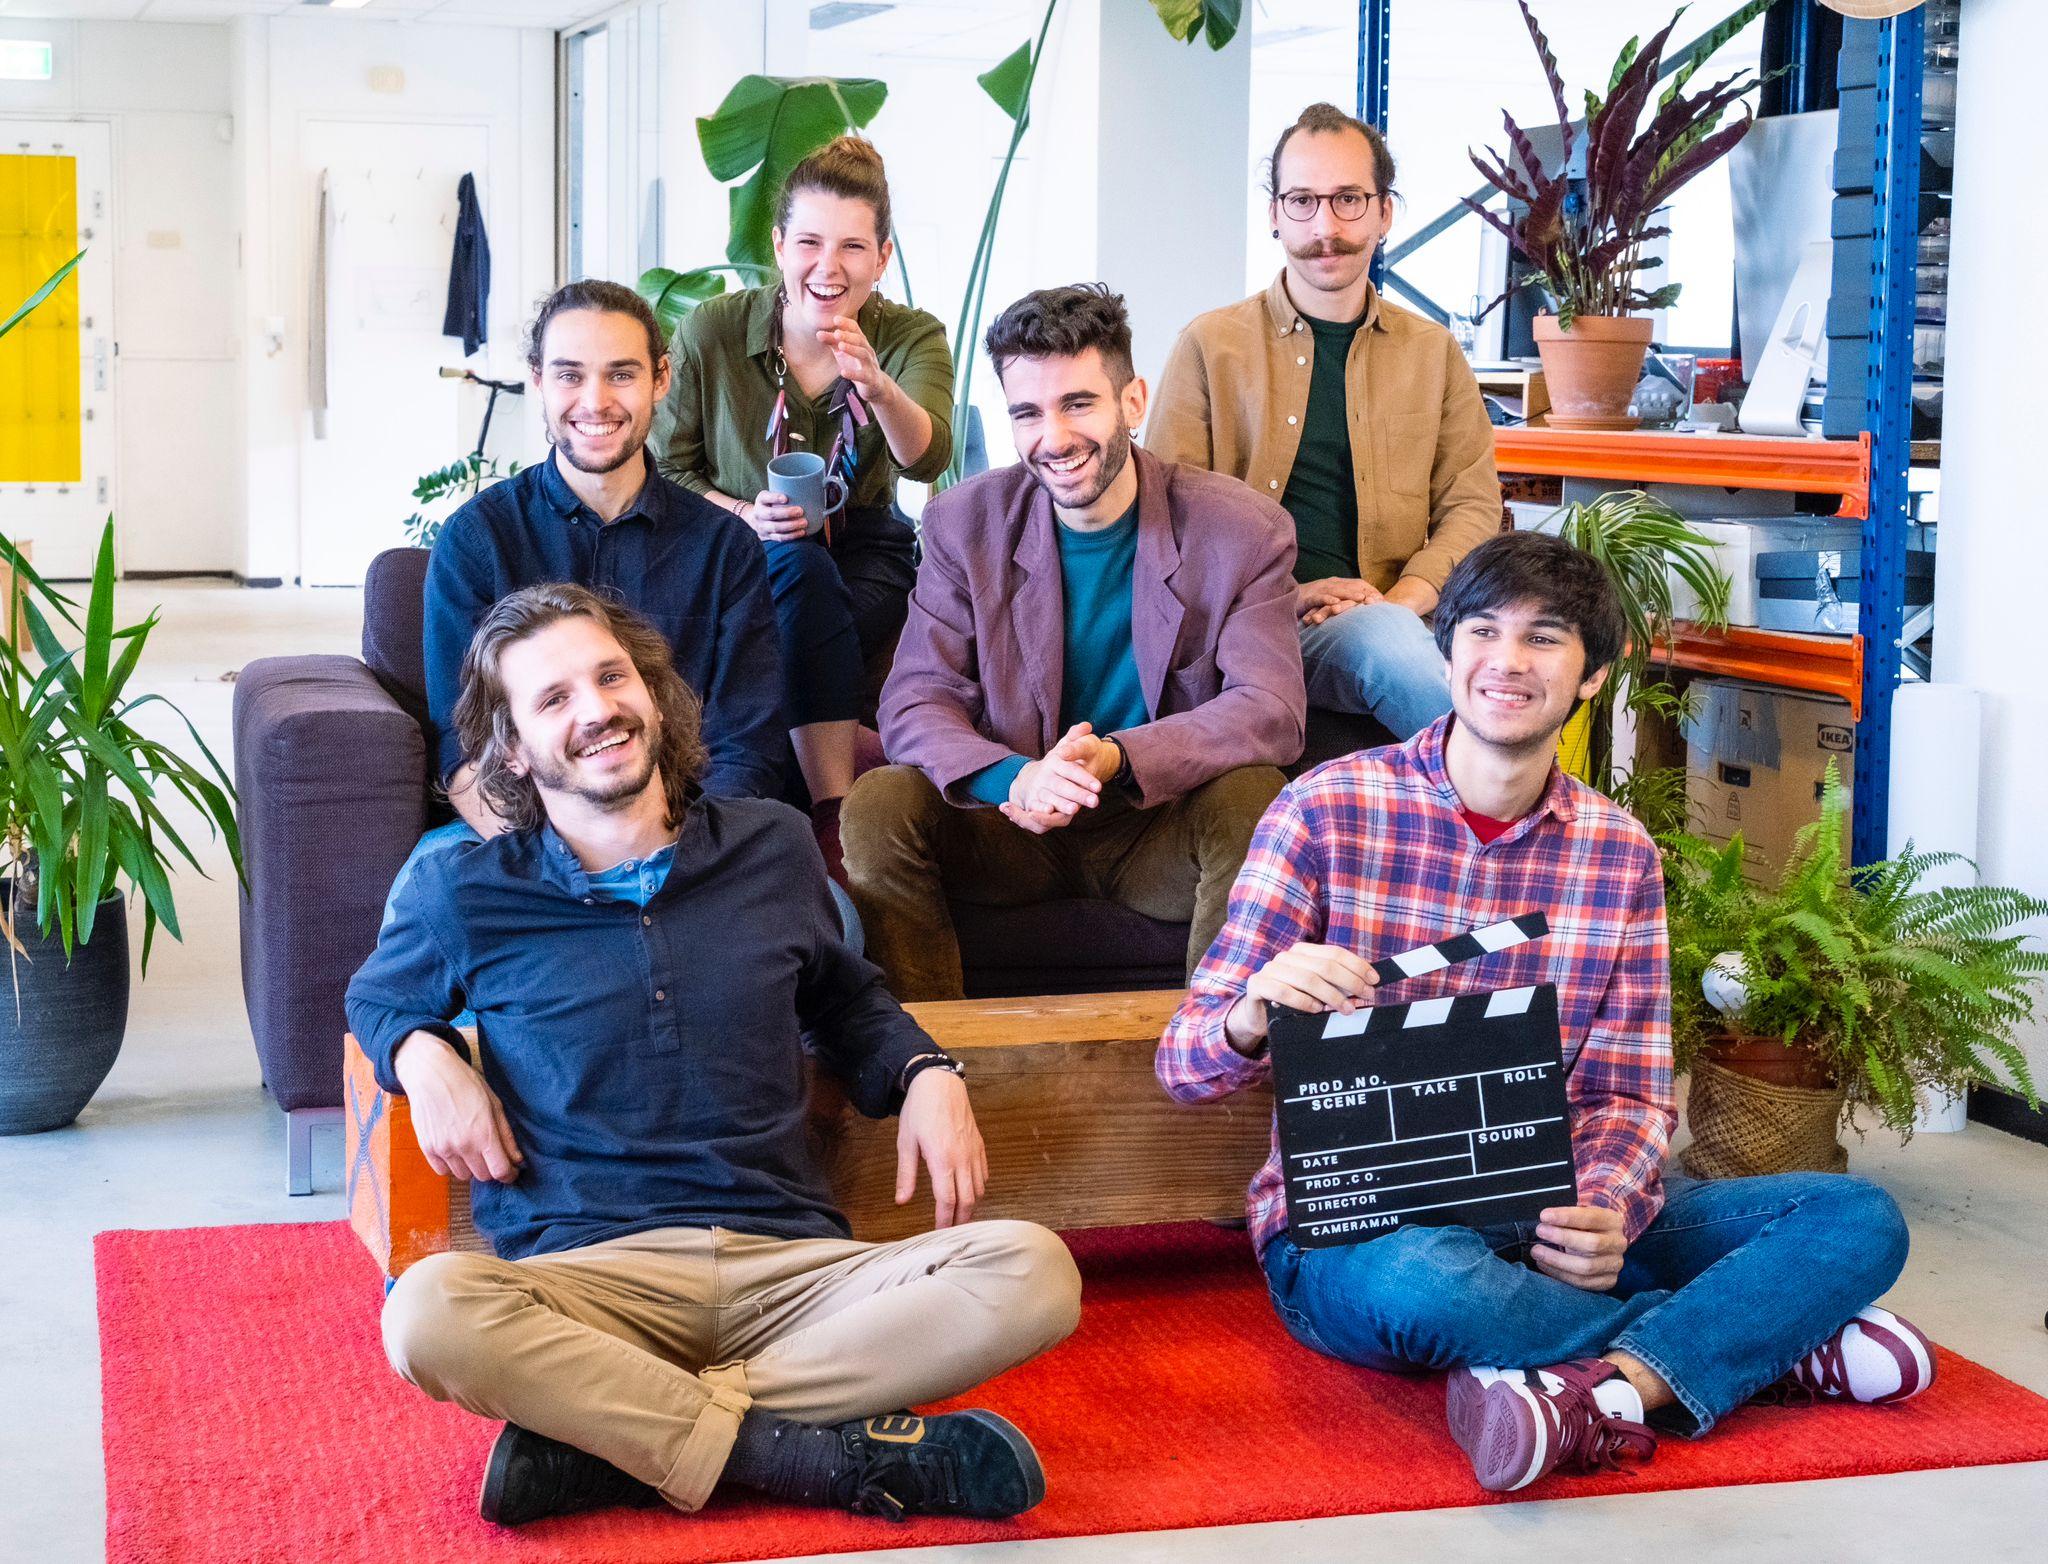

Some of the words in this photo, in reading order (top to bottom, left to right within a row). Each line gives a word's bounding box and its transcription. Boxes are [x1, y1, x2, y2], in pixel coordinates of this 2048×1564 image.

[1820, 731, 1851, 745] IKEA
[1503, 1068, 1547, 1084] ROLL
[1411, 1080, 1458, 1097] TAKE
[1311, 1093, 1367, 1112] SCENE
[1478, 1126, 1536, 1144] SOUND
[1302, 1155, 1339, 1169] DATE
[1308, 1194, 1377, 1213] DIRECTOR
[1311, 1215, 1399, 1237] CAMERAMAN
